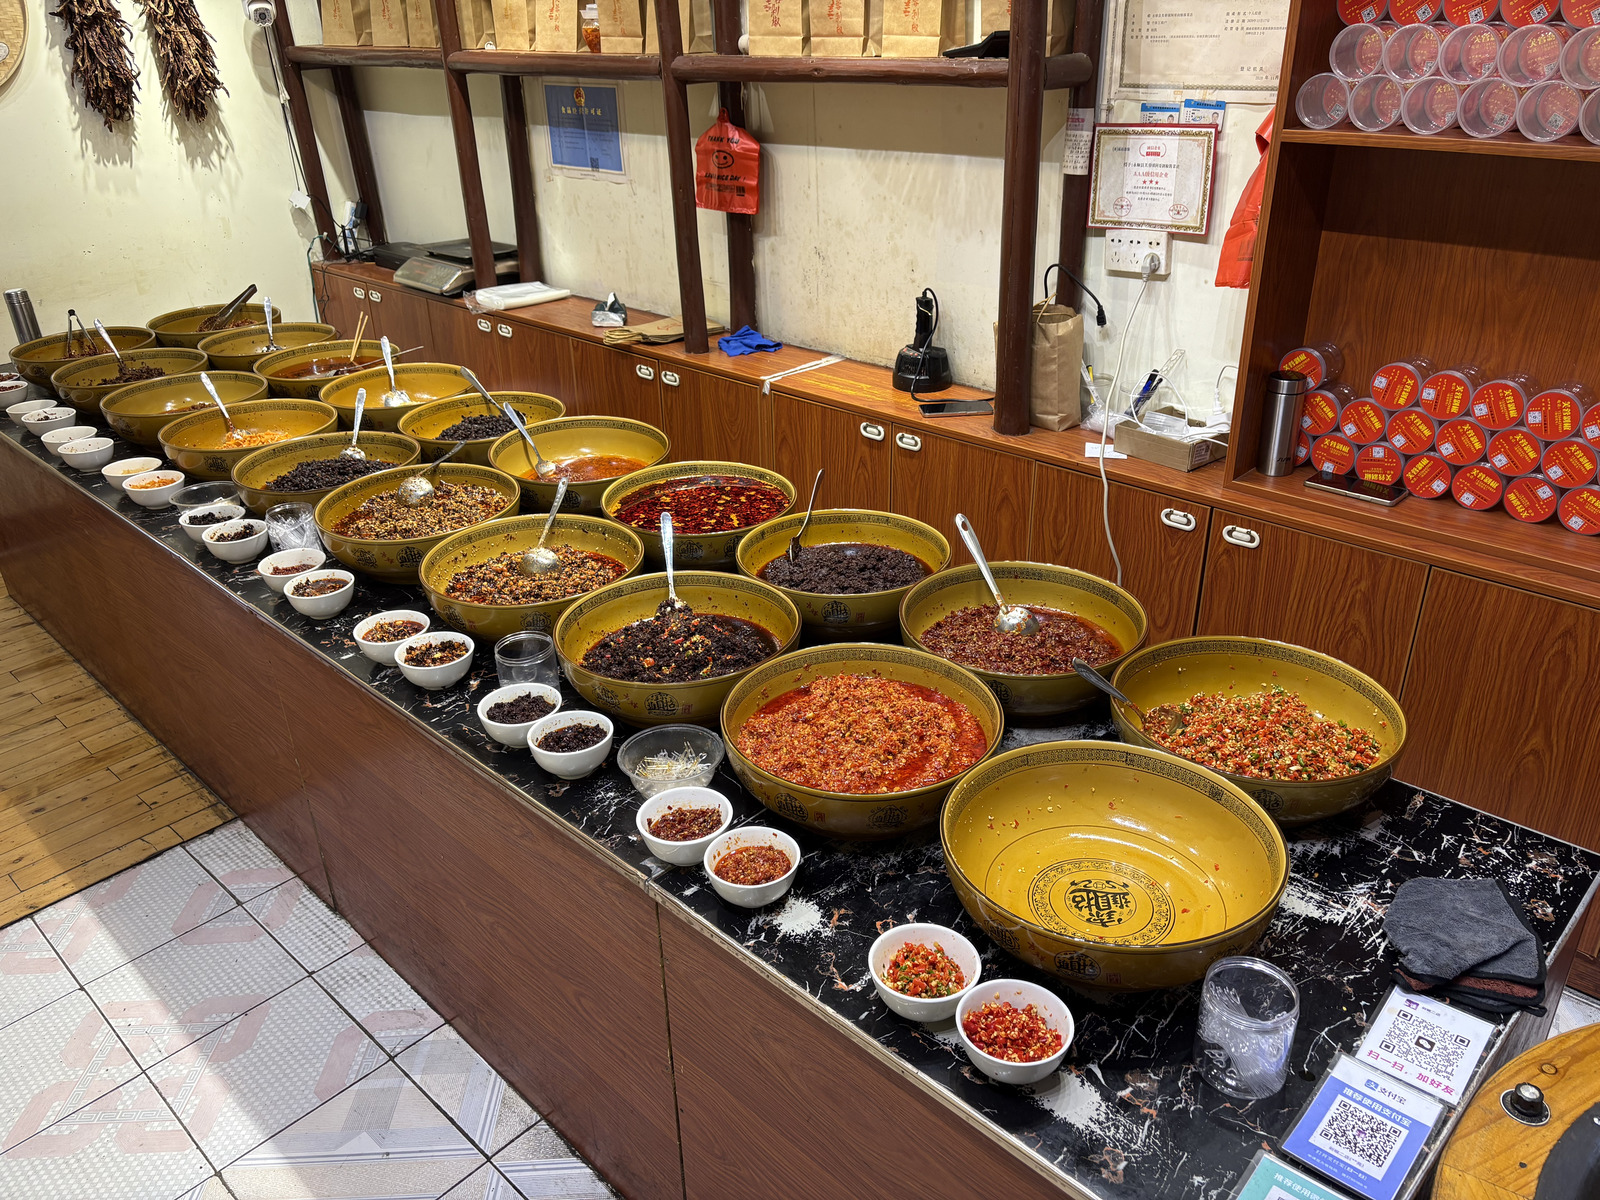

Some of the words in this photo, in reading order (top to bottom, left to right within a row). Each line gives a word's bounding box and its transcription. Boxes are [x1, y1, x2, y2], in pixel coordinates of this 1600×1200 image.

[708, 135, 724, 143] THANK
[727, 137, 740, 145] YOU
[1378, 1086, 1407, 1105] 支付宝
[1343, 1087, 1412, 1127] 推荐使用支付宝
